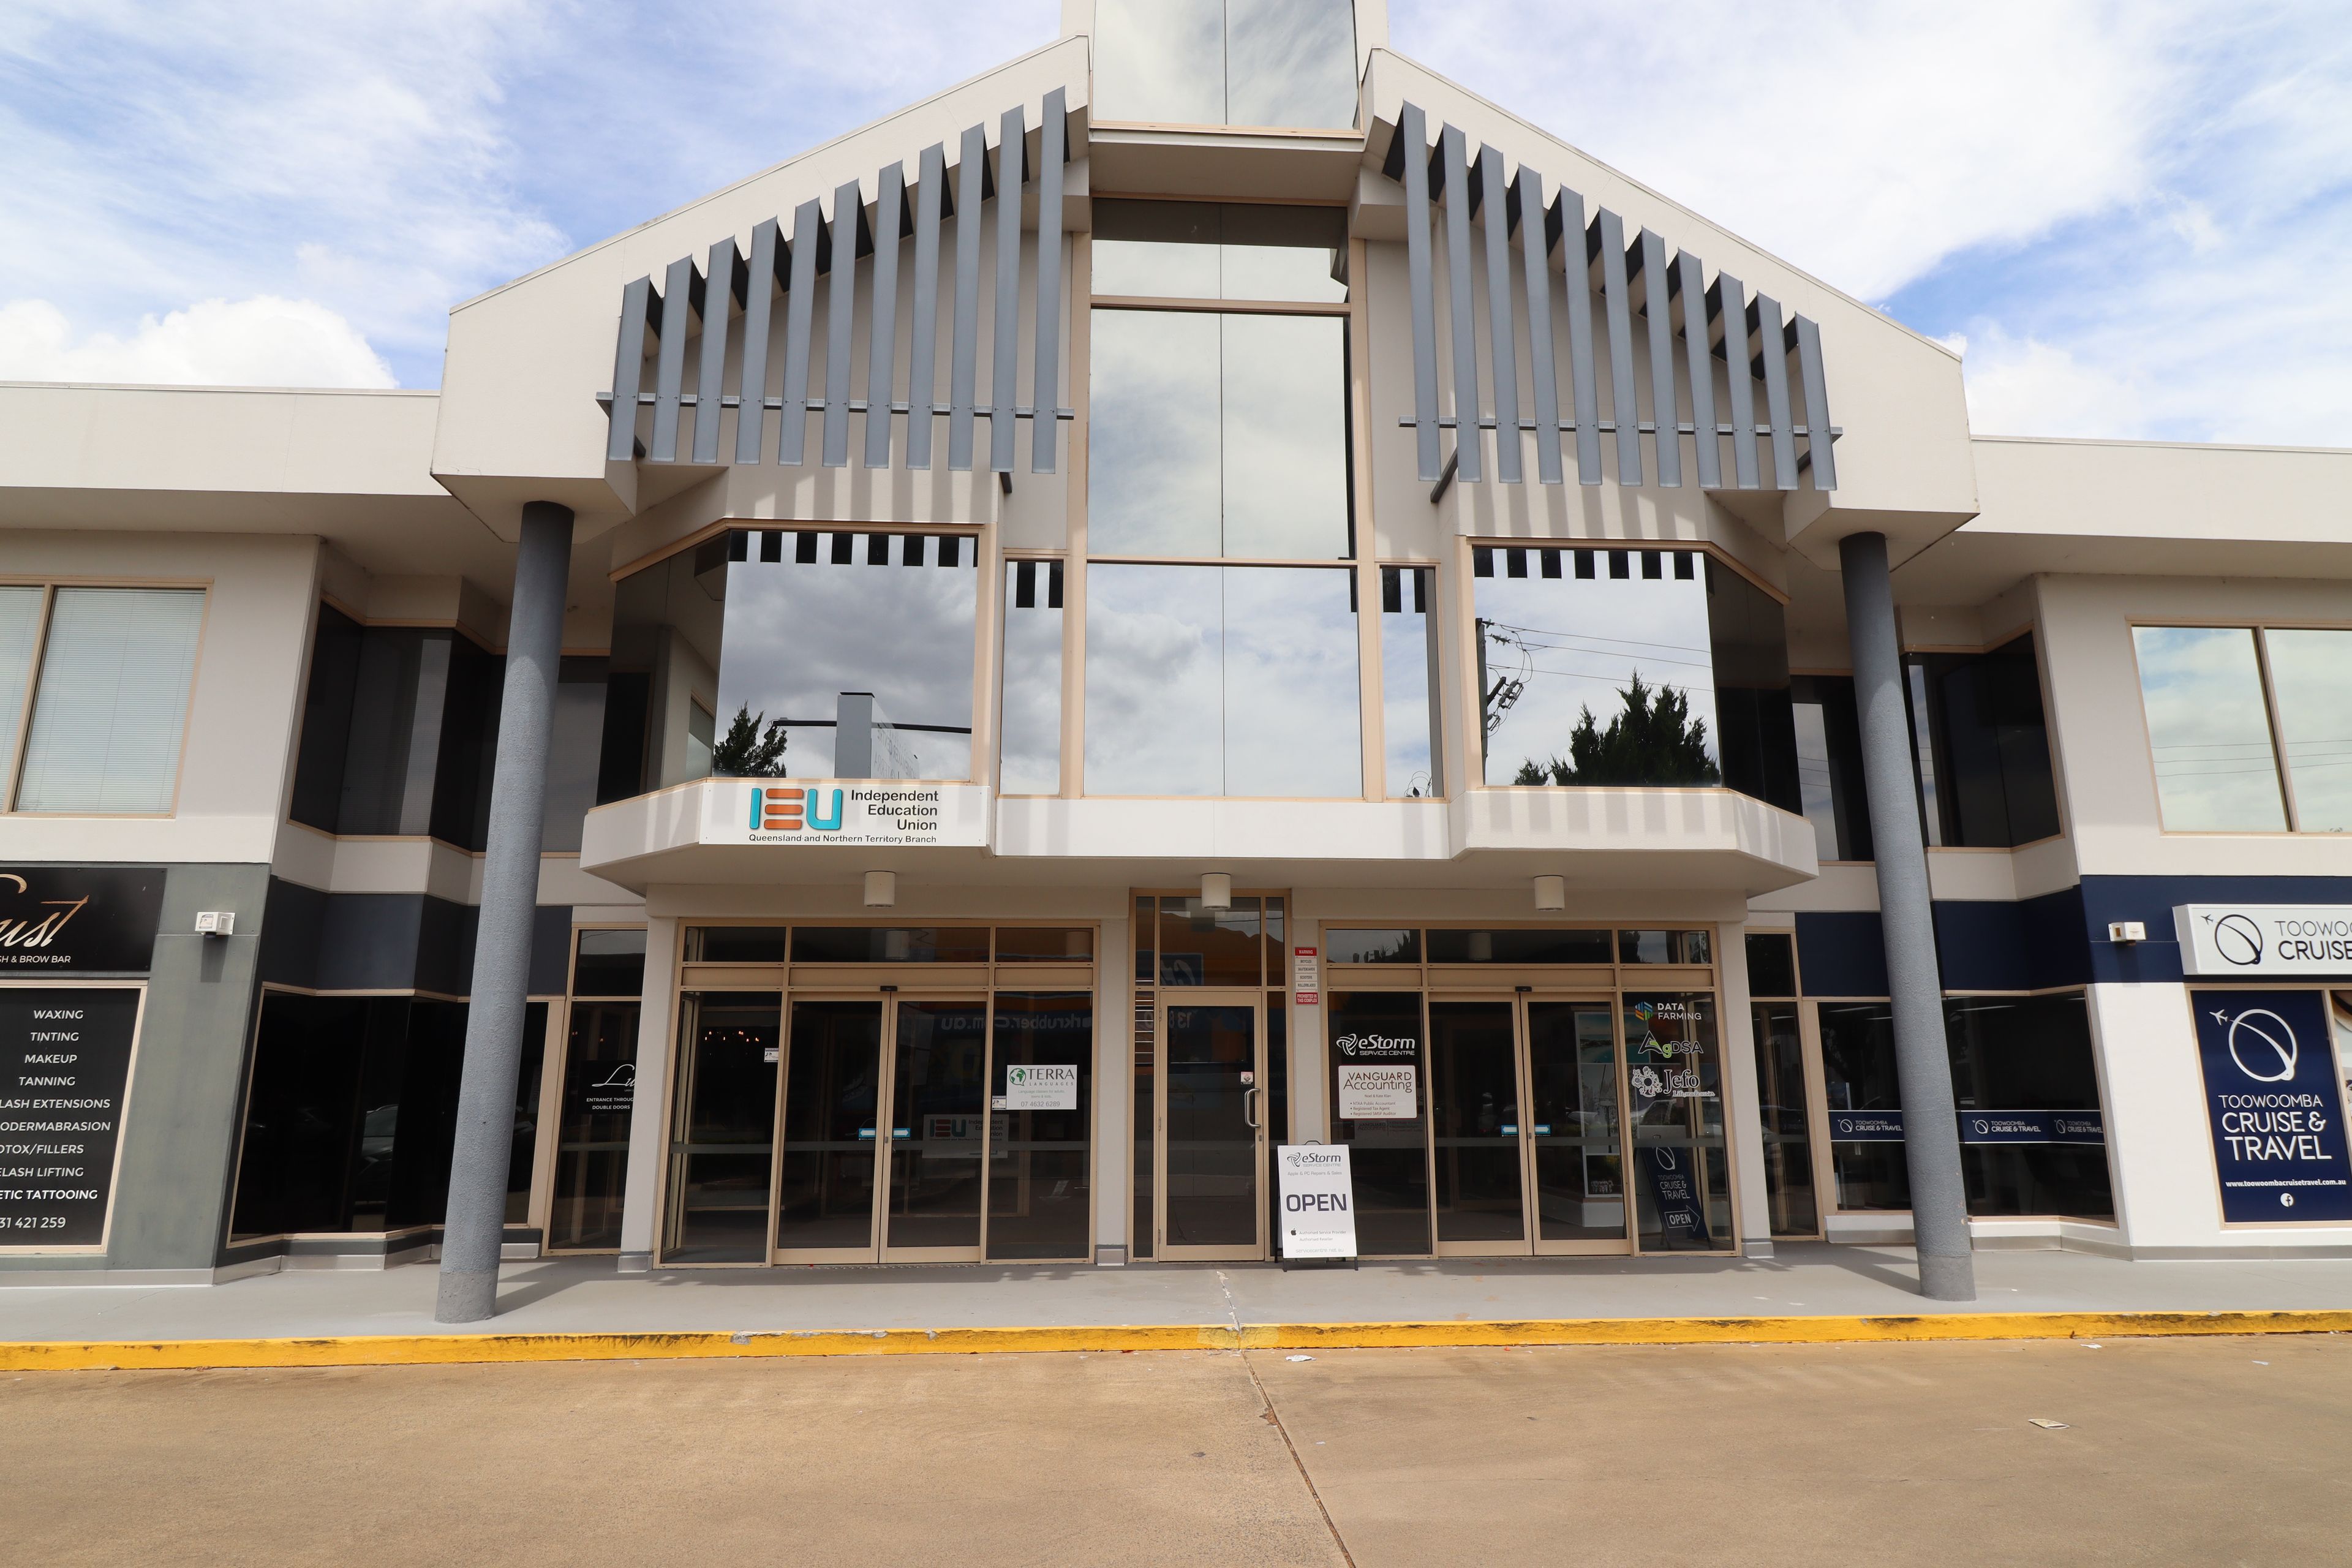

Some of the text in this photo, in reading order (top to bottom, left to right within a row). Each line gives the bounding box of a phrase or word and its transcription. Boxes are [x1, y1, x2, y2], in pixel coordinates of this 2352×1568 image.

[851, 790, 939, 803] Independent
[749, 788, 843, 830] IEU
[868, 804, 937, 816] Education
[897, 819, 937, 831] Union
[865, 835, 903, 844] Territory
[2274, 921, 2352, 937] TOOWO
[2278, 940, 2352, 960] CRUISE
[34, 1010, 83, 1019] WAXING
[31, 1032, 79, 1041] TINTING
[1359, 1035, 1415, 1049] eStorm
[1638, 1030, 1704, 1058] AgDSA
[24, 1055, 77, 1063] MAKEUP
[592, 1064, 636, 1087] Lu
[1027, 1068, 1074, 1080] TERRA
[1348, 1072, 1412, 1080] VANGUARD
[19, 1077, 75, 1086] TANNING
[1343, 1079, 1412, 1093] Accounting
[1664, 1069, 1700, 1094] Jefo
[33, 1099, 110, 1108] EXTENSIONS
[2218, 1095, 2323, 1108] TOOWOOMBA
[0, 1122, 111, 1131] ODERMABRASION
[2222, 1111, 2326, 1133] CRUISE &
[2225, 1136, 2332, 1161] TRAVEL
[1302, 1153, 1341, 1163] eStorm
[37, 1167, 84, 1177] LIFTING
[1660, 1181, 1681, 1189] CRUISE
[26, 1190, 98, 1199] TATTOOING
[1662, 1189, 1690, 1200] TRAVEL
[1286, 1194, 1347, 1212] OPEN
[15, 1217, 37, 1228] 421
[40, 1217, 66, 1228] 259
[1669, 1213, 1691, 1224] OPEN
